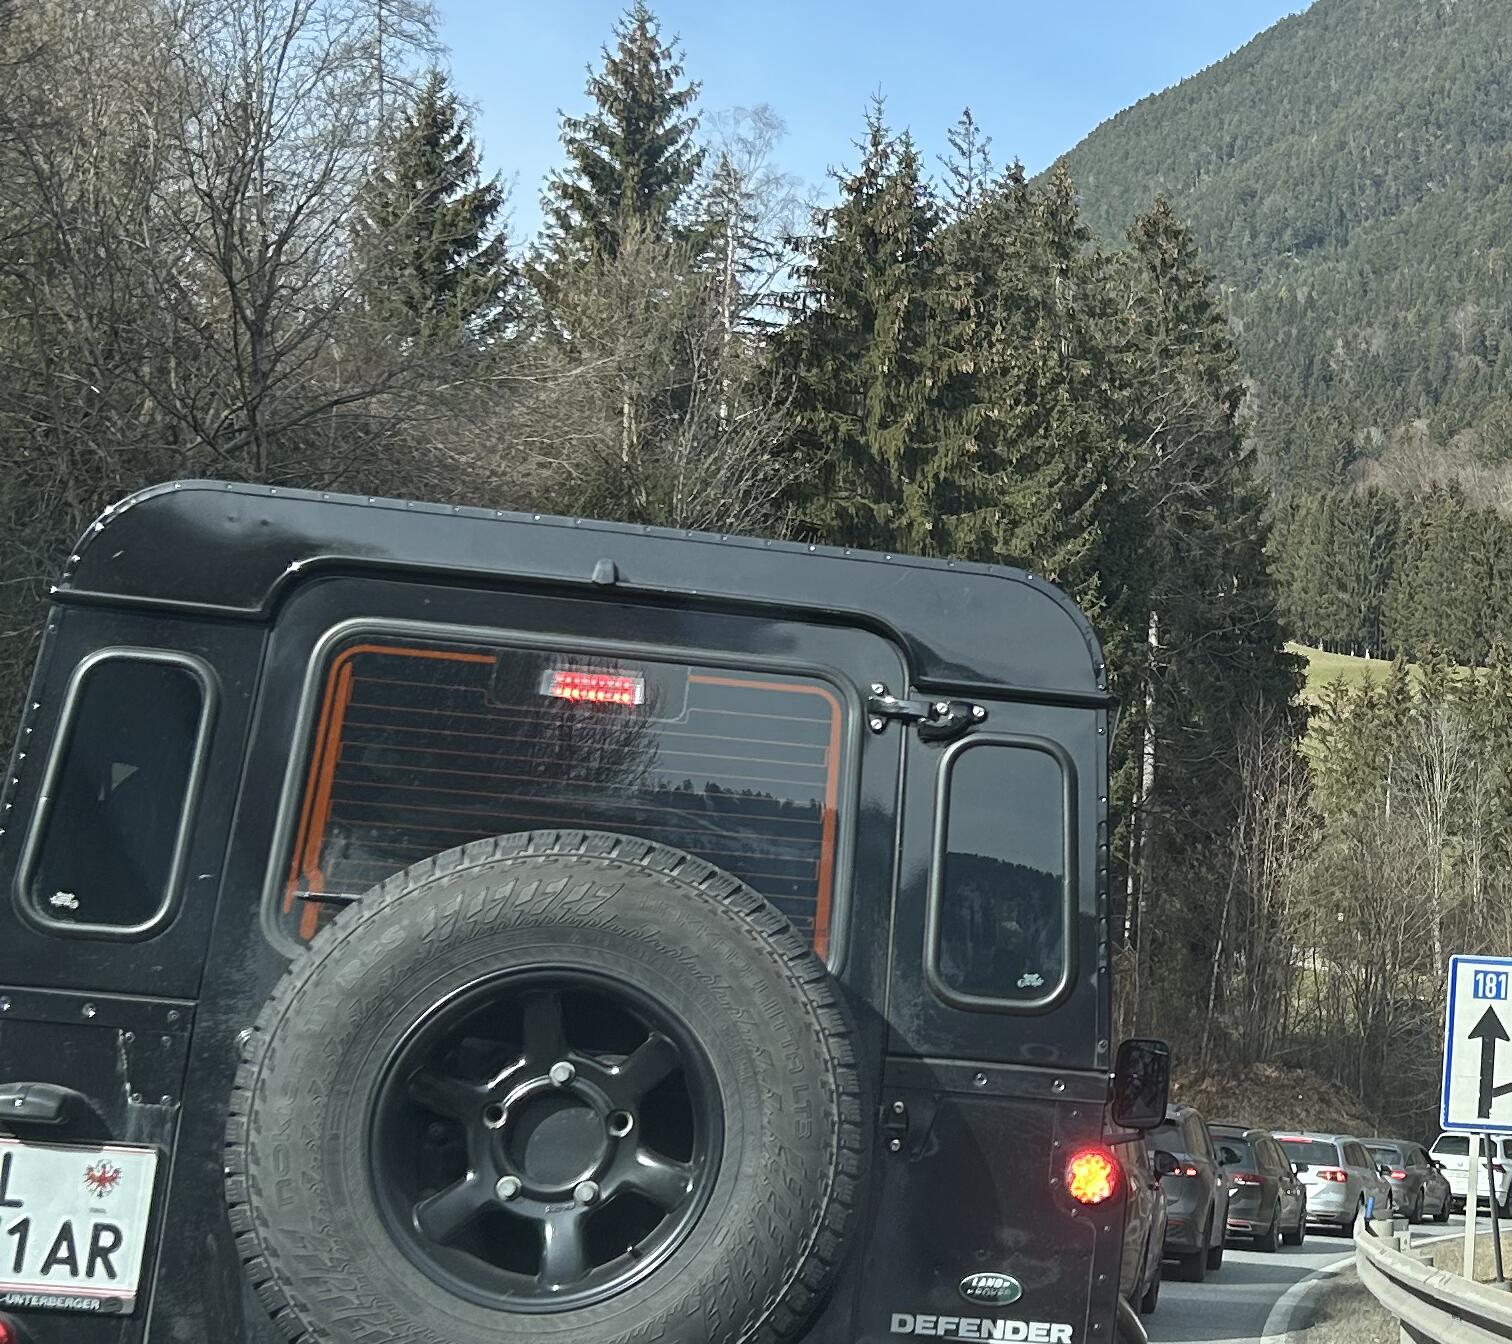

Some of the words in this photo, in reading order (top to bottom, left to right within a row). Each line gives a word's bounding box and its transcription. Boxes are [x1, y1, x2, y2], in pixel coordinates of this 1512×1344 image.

[1475, 972, 1507, 999] 181
[0, 1217, 123, 1280] 1AR
[972, 1277, 1003, 1288] LAND
[5, 1293, 100, 1310] UNTERBERGER
[891, 1313, 1073, 1344] DEFENDER
